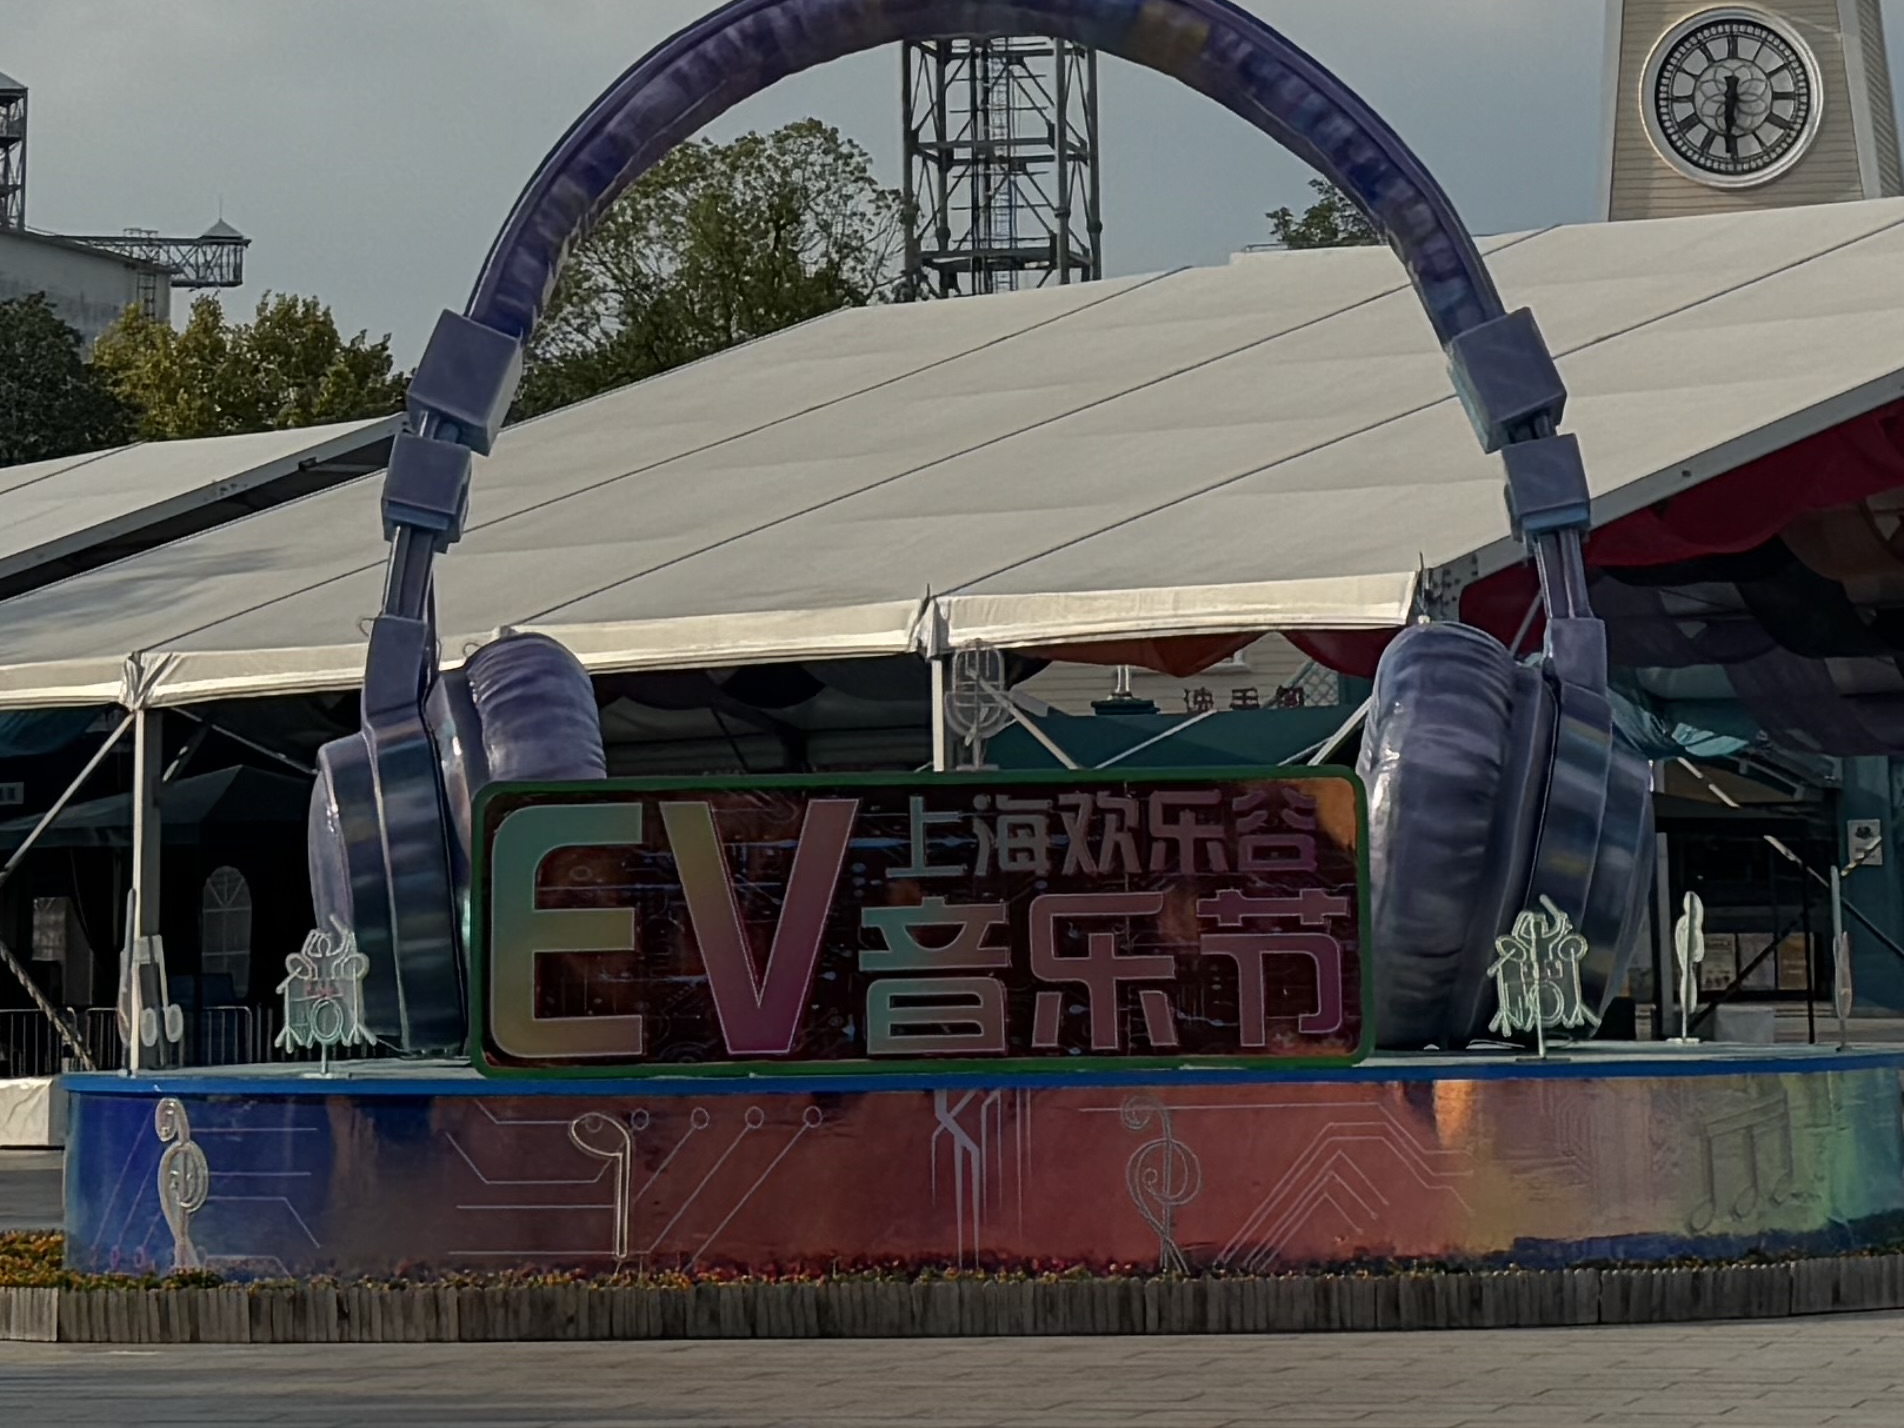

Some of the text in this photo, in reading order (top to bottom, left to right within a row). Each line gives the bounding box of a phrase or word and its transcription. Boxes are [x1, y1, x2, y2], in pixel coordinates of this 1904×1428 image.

[886, 791, 1316, 878] 上海欢乐谷
[490, 797, 860, 1058] EV
[859, 892, 1349, 1054] 音乐节
